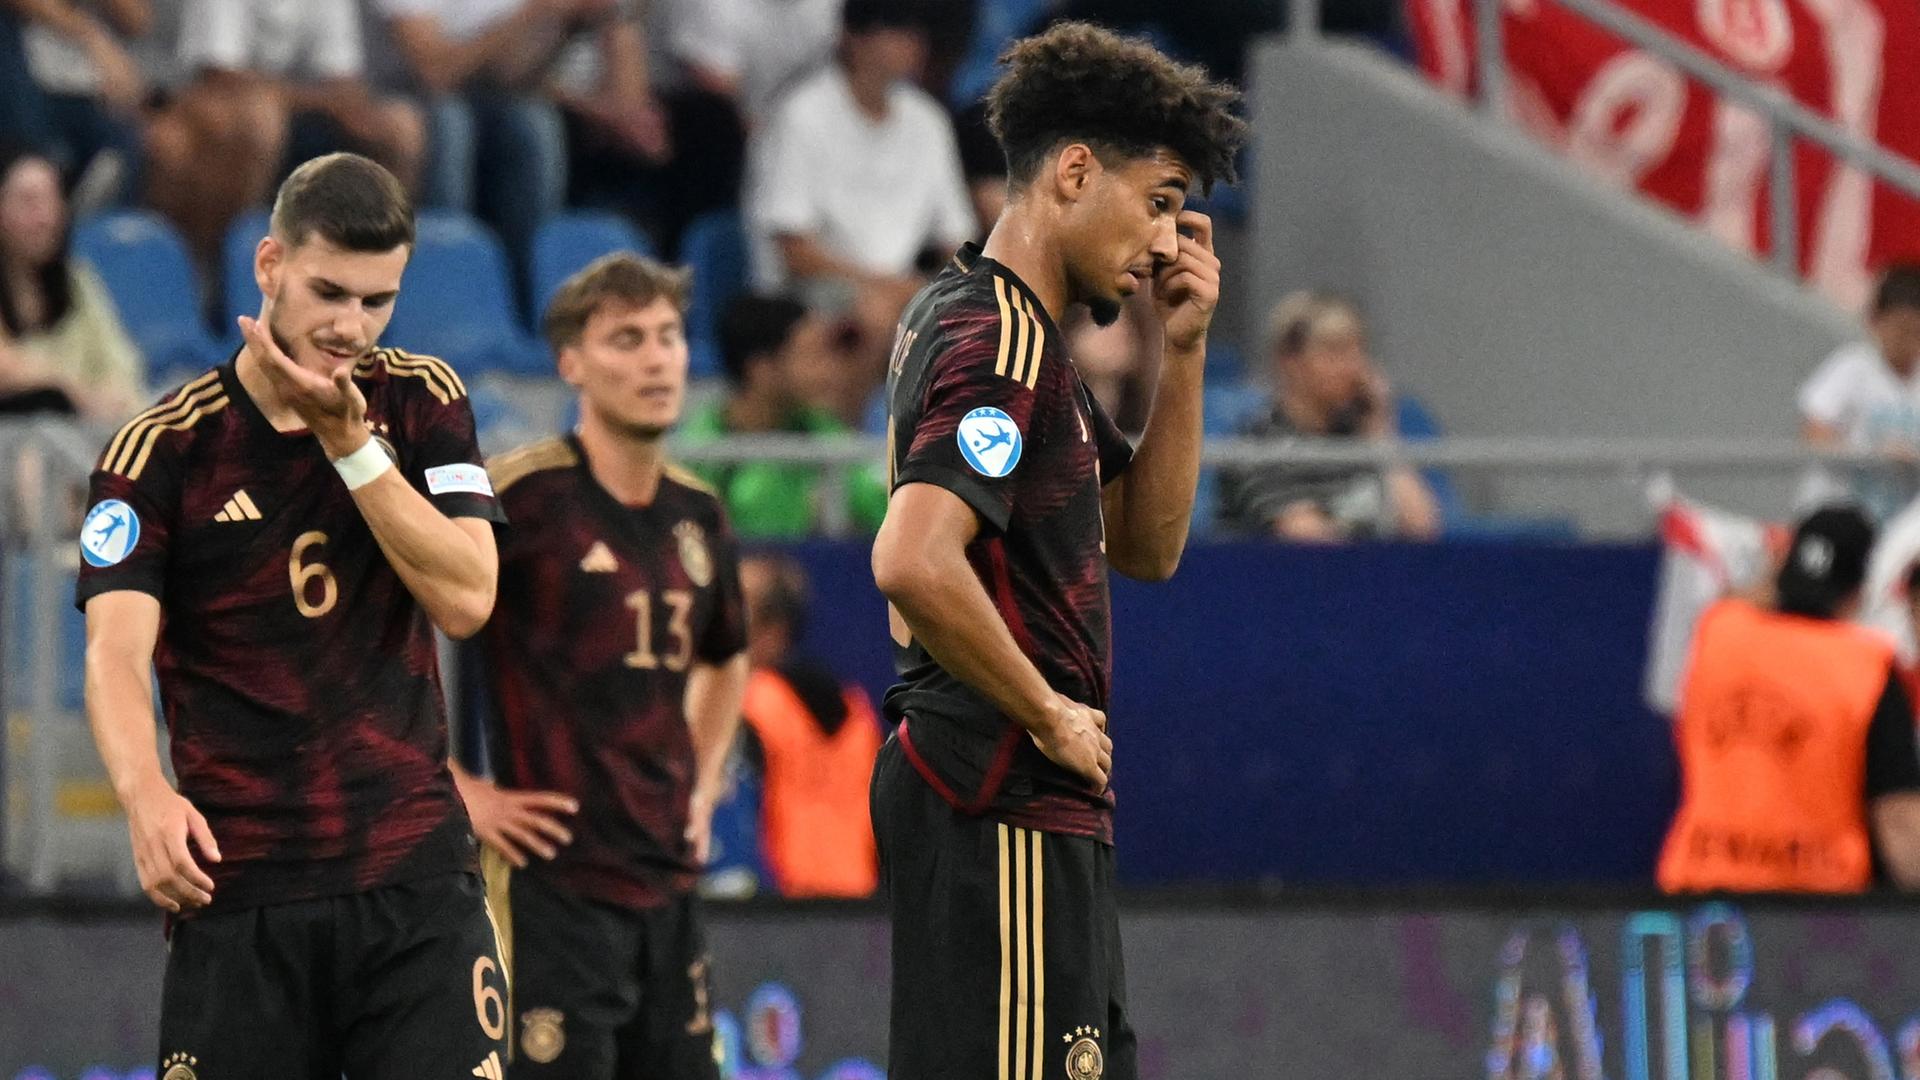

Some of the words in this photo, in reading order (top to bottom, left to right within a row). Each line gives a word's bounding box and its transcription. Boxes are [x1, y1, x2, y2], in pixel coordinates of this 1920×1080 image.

[289, 530, 338, 618] 6
[624, 590, 694, 671] 13
[473, 956, 505, 1041] 6
